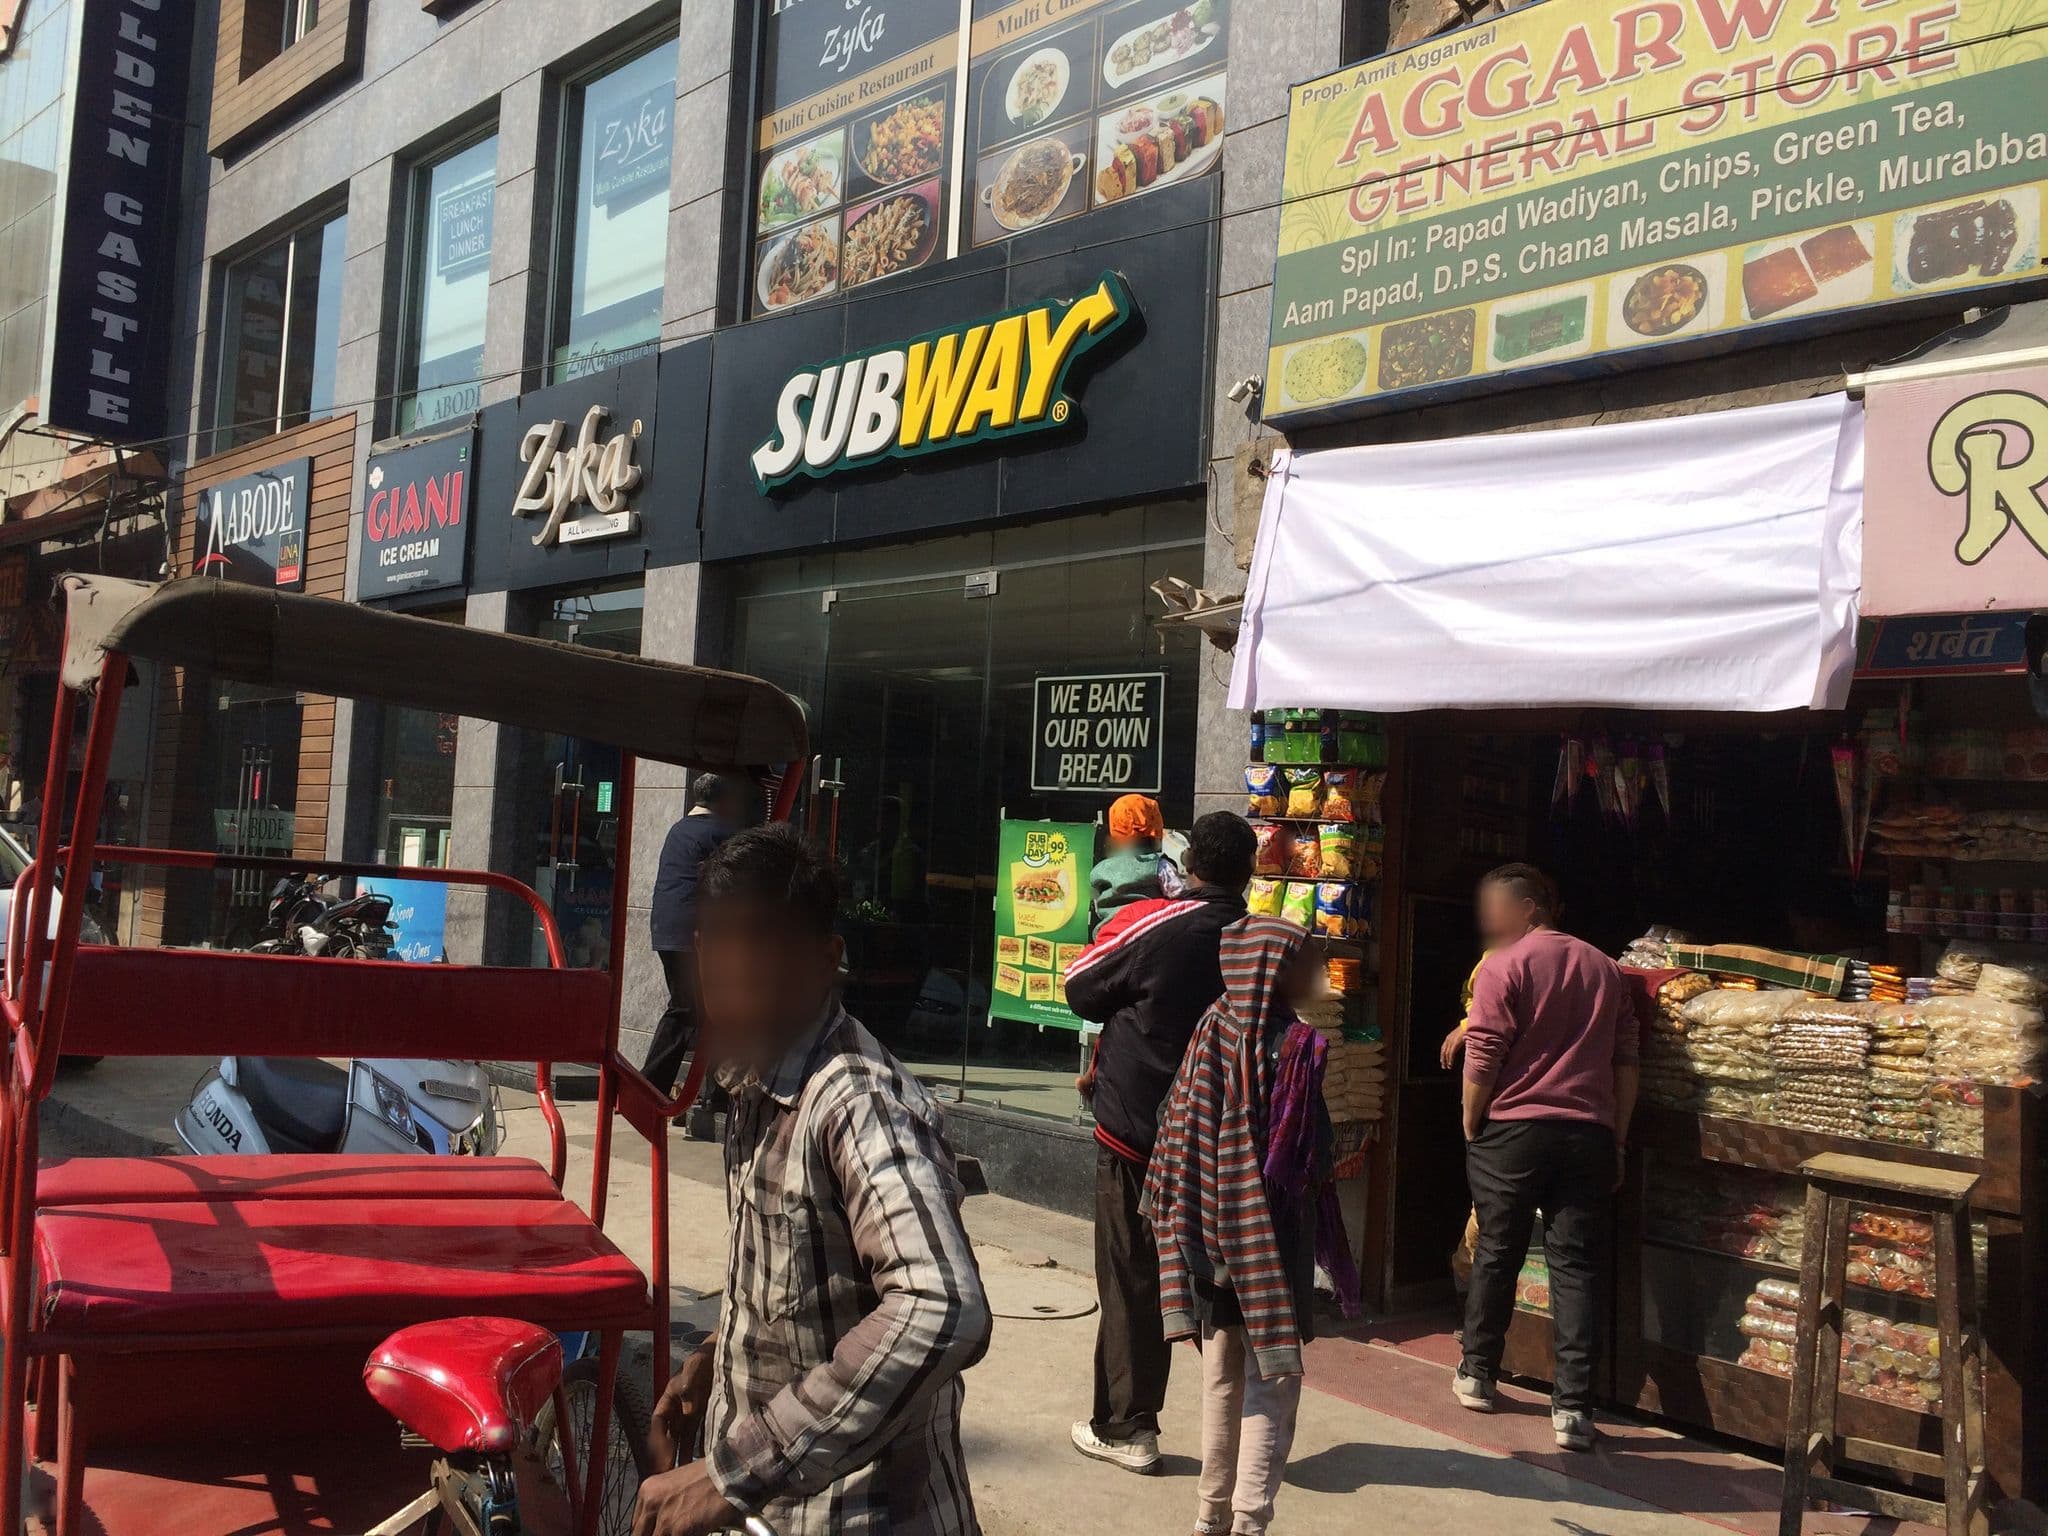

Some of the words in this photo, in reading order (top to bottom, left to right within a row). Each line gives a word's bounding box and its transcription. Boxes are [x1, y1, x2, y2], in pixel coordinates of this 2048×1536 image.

[819, 6, 885, 72] Zyka
[997, 3, 1040, 39] Multi
[771, 109, 804, 137] Multi
[807, 90, 854, 121] Cuisine
[858, 53, 935, 100] Restaurant
[1302, 82, 1348, 106] Prop.
[1354, 59, 1397, 88] Amit
[1402, 26, 1497, 73] Aggarwal
[1337, 0, 1898, 164] AGGARW
[600, 99, 666, 164] Zyka
[1349, 97, 1655, 223] GENERAL
[1680, 5, 1957, 132] STORE
[442, 188, 492, 222] BREAKFAST
[1340, 239, 1380, 278] Spl
[1387, 235, 1416, 261] In:
[1425, 206, 1507, 253] Papad
[1516, 178, 1648, 231] Wadiyan,
[1659, 149, 1761, 195] Chips,
[1773, 117, 1879, 166] Green
[1891, 101, 1966, 137] Tea,
[448, 233, 485, 261] DINNER
[450, 215, 484, 239] LUNCH
[1282, 301, 1335, 328] Aam
[1341, 275, 1424, 315] Papad,
[1433, 254, 1508, 295] D.P.S.
[1518, 230, 1610, 275] Chana
[1619, 201, 1739, 251] Masala,
[1751, 172, 1865, 222] Pickle,
[88, 192, 143, 424] CASTLE
[607, 343, 658, 366] Restaurant
[752, 282, 1118, 482] SUBWAY
[367, 470, 464, 543] GIANI
[512, 404, 642, 546] Zyka
[224, 475, 295, 546] ABODE
[379, 546, 398, 567] ICE
[400, 538, 440, 564] CREAM
[1050, 684, 1083, 713] WE
[1087, 682, 1146, 713] BAKE
[1044, 718, 1090, 748] OUR
[1095, 717, 1151, 748] OWN
[1058, 753, 1132, 783] BREAD
[1028, 834, 1046, 843] SUB
[1028, 848, 1045, 858] DAY
[1050, 841, 1065, 853] 99
[199, 1090, 242, 1153] HONDA
